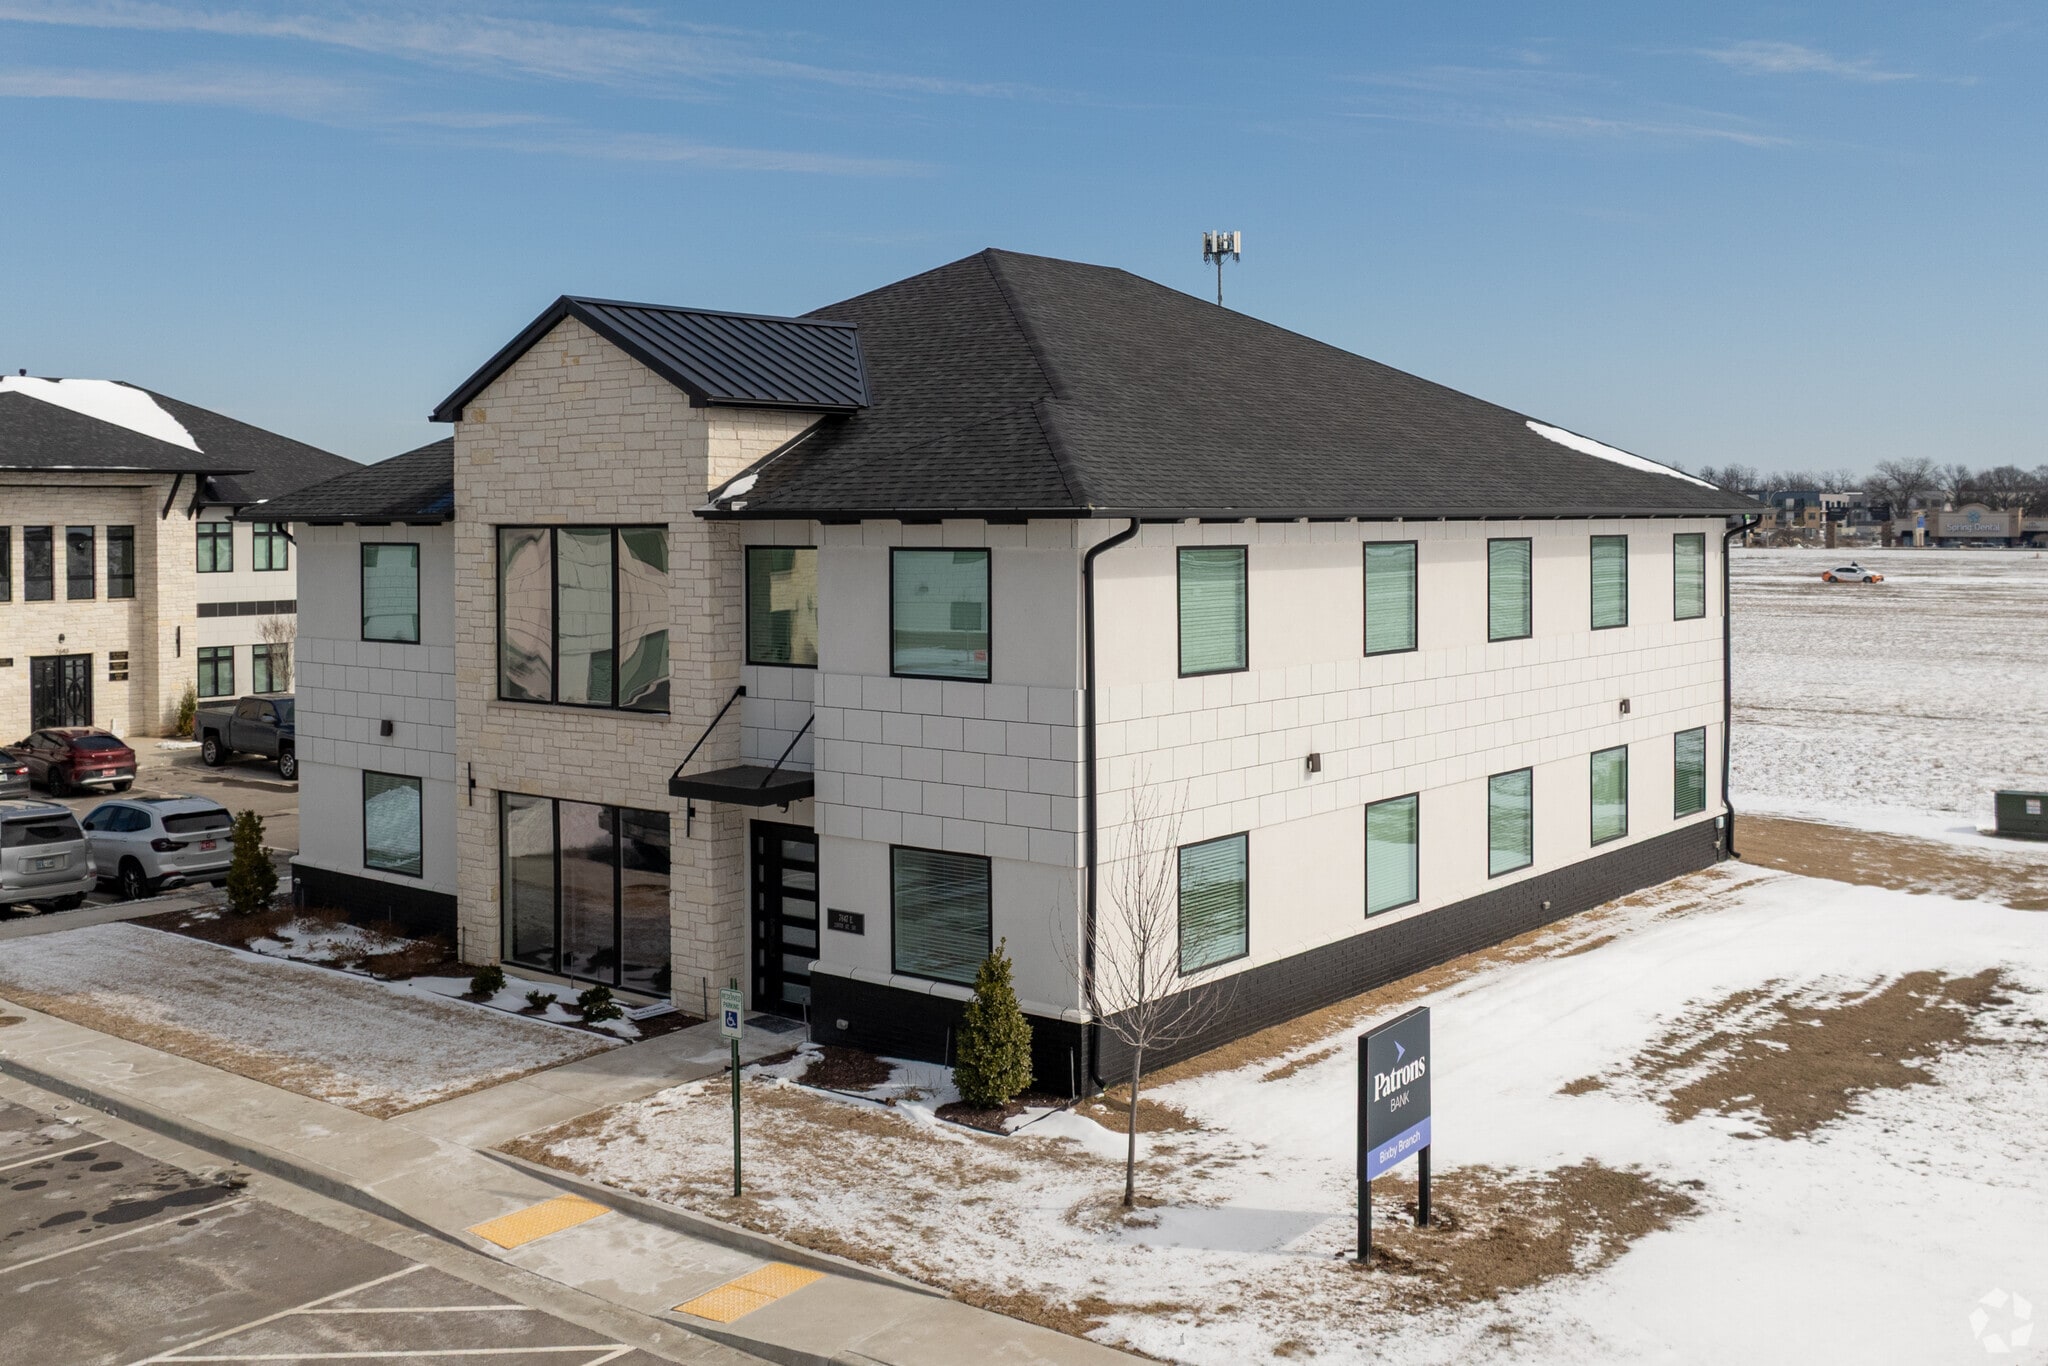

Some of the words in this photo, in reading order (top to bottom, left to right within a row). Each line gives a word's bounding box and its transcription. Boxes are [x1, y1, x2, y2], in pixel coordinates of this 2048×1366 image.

[1946, 523, 1972, 533] Spring
[1974, 522, 2001, 532] Dental
[722, 1000, 740, 1010] PARKING
[1373, 1056, 1426, 1102] Patrons
[1390, 1090, 1410, 1113] BANK
[1379, 1144, 1398, 1164] Bixby
[1398, 1131, 1421, 1152] Branch
